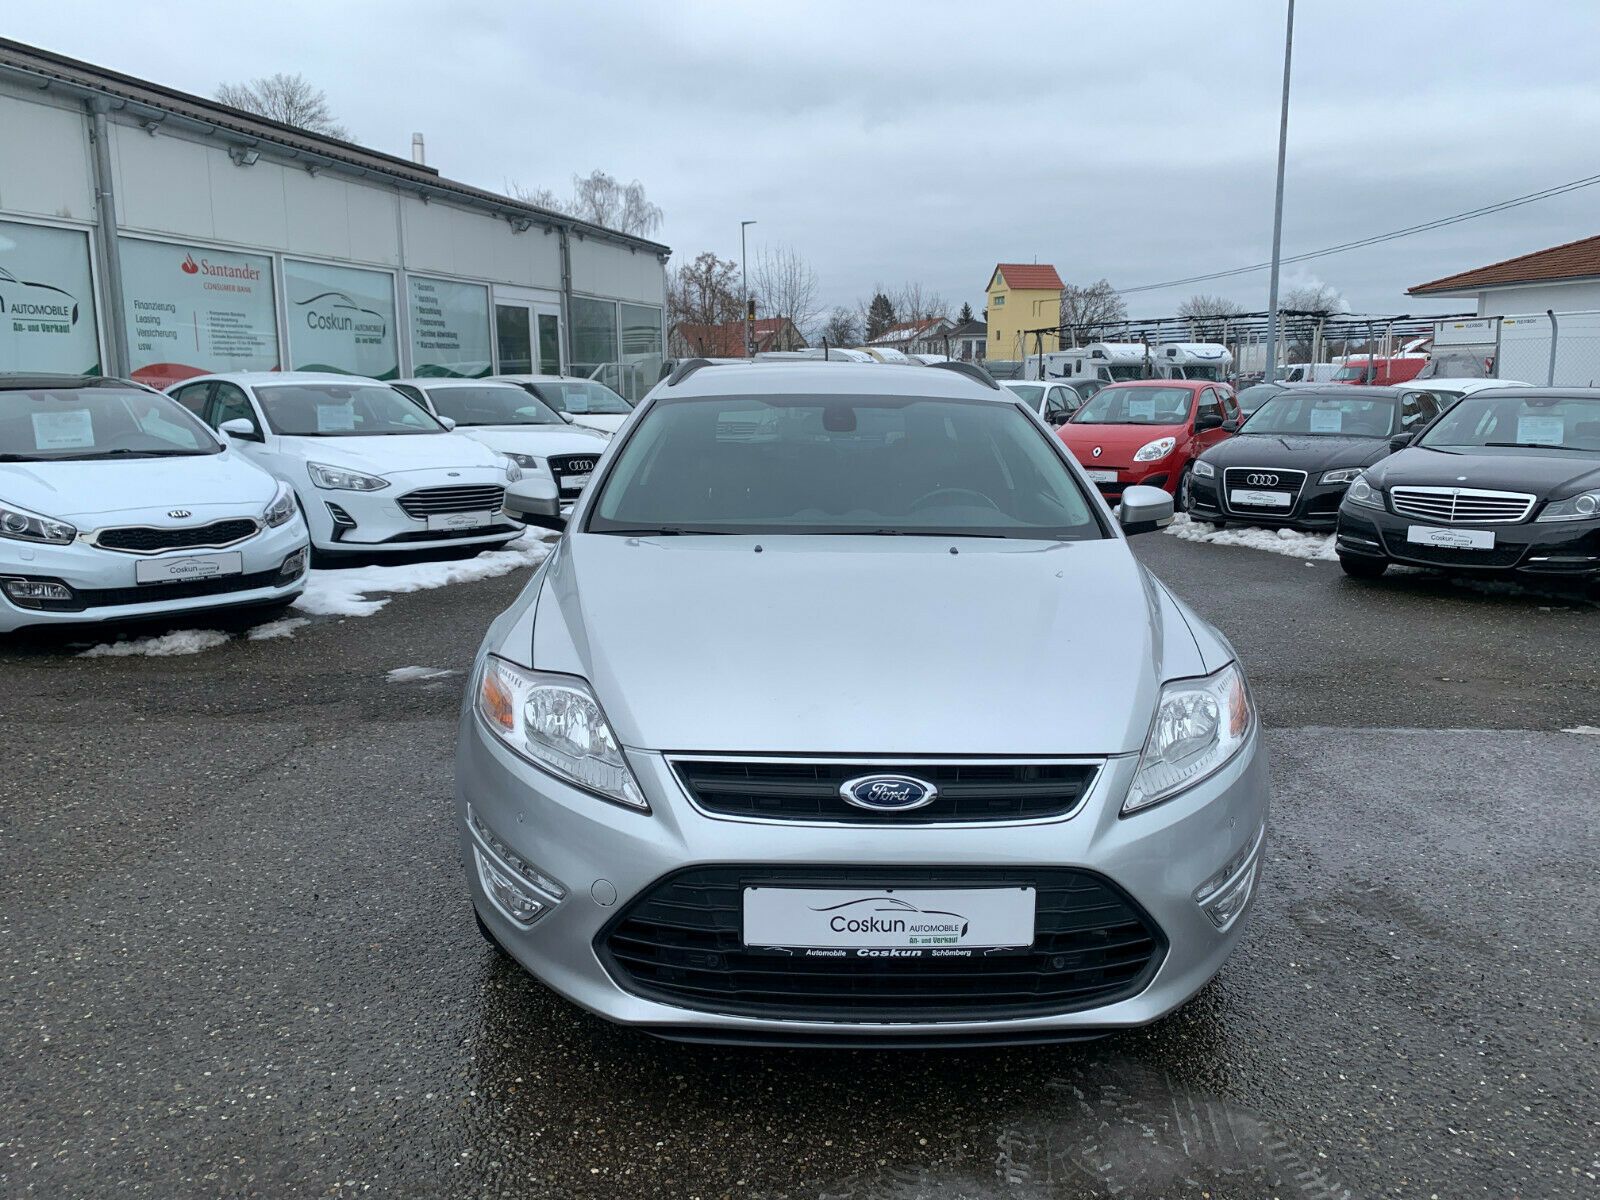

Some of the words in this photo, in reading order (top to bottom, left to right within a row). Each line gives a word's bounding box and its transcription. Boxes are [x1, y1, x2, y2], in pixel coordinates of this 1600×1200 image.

[201, 259, 260, 280] Santander
[203, 282, 235, 292] CONSUMER
[236, 285, 251, 293] BANK
[11, 303, 69, 316] AUTOMOBILE
[134, 300, 176, 313] Finanzierung
[135, 315, 160, 326] Leasing
[307, 311, 353, 330] Coskun
[28, 324, 40, 332] und
[41, 323, 70, 334] Verkauf
[136, 328, 177, 340] Versicherung
[169, 510, 189, 518] KIA
[169, 566, 198, 574] Coskun
[868, 783, 910, 801] Ford
[830, 915, 905, 933] Coskun
[909, 924, 959, 932] AUTOMOBILE
[932, 936, 958, 944] Verkauf
[806, 949, 847, 957] Automobile
[856, 949, 922, 957] Coskun
[931, 949, 972, 957] Schömberg
